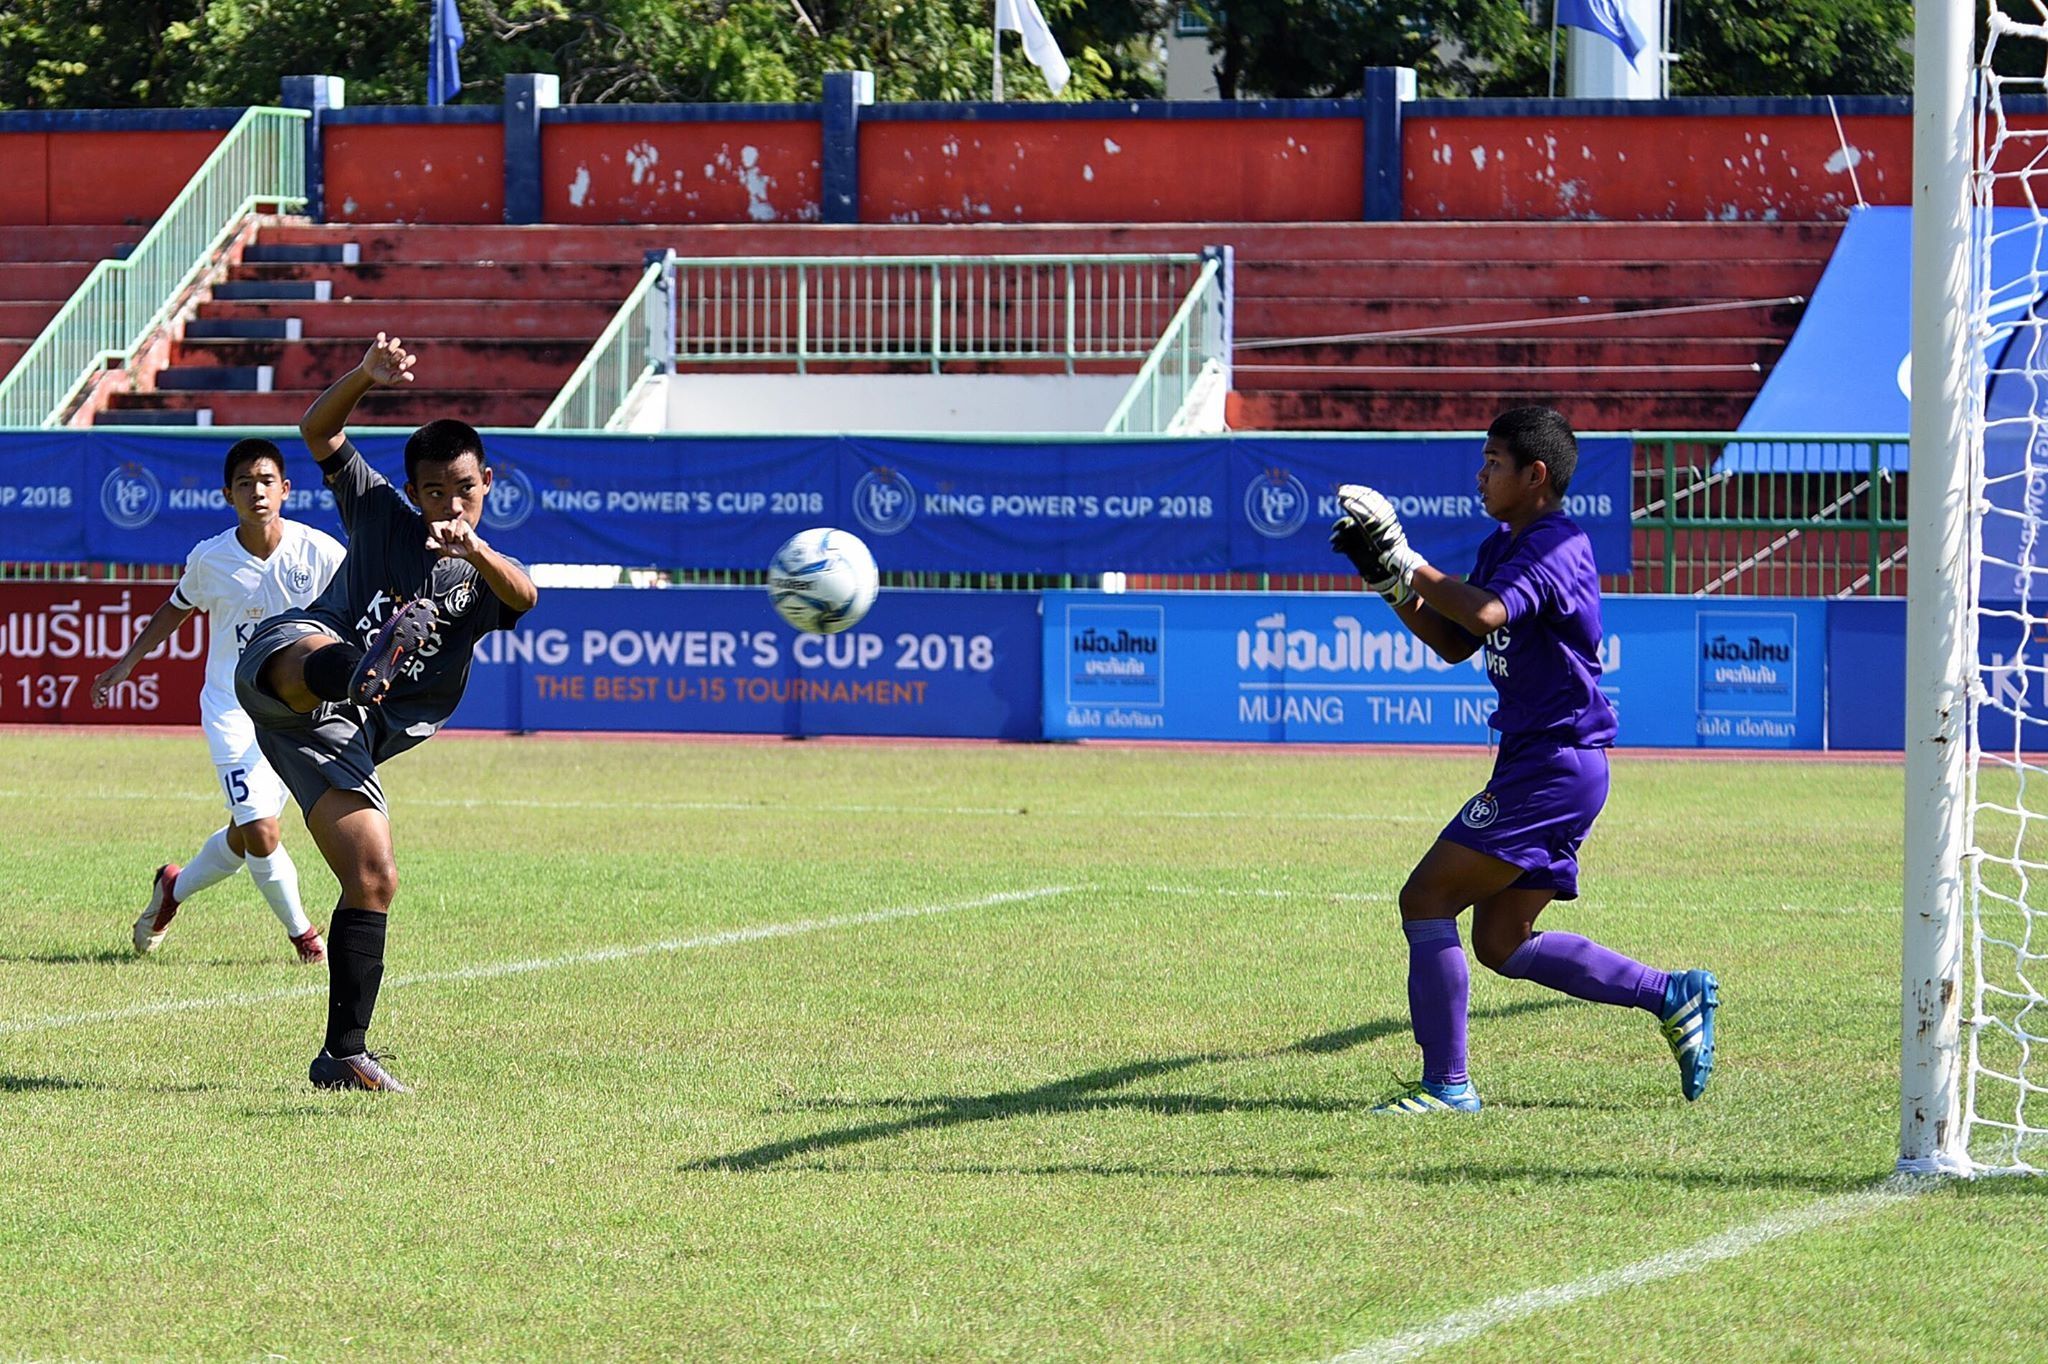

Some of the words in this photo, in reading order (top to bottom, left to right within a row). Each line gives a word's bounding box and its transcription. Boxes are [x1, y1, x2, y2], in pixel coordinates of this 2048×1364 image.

[21, 486, 72, 508] 2018
[169, 488, 226, 511] KING
[284, 489, 335, 511] ER'S
[541, 490, 600, 512] KING
[607, 491, 711, 514] POWER'S
[716, 491, 765, 514] CUP
[771, 491, 824, 514] 2018
[924, 493, 986, 516] KING
[991, 495, 1100, 517] POWER'S
[1104, 495, 1153, 517] CUP
[1159, 495, 1213, 517] 2018
[474, 629, 569, 664] KING
[584, 631, 779, 668] POWER'S
[794, 632, 883, 669] CUP
[895, 634, 994, 671] 2018
[17, 674, 80, 708] 137
[535, 675, 586, 699] THE
[597, 676, 658, 701] BEST
[666, 677, 725, 702] U-15
[733, 679, 928, 705] TOURNAMENT
[1239, 697, 1344, 724] MUANG
[1367, 697, 1432, 724] THAI
[224, 768, 250, 807] 15
